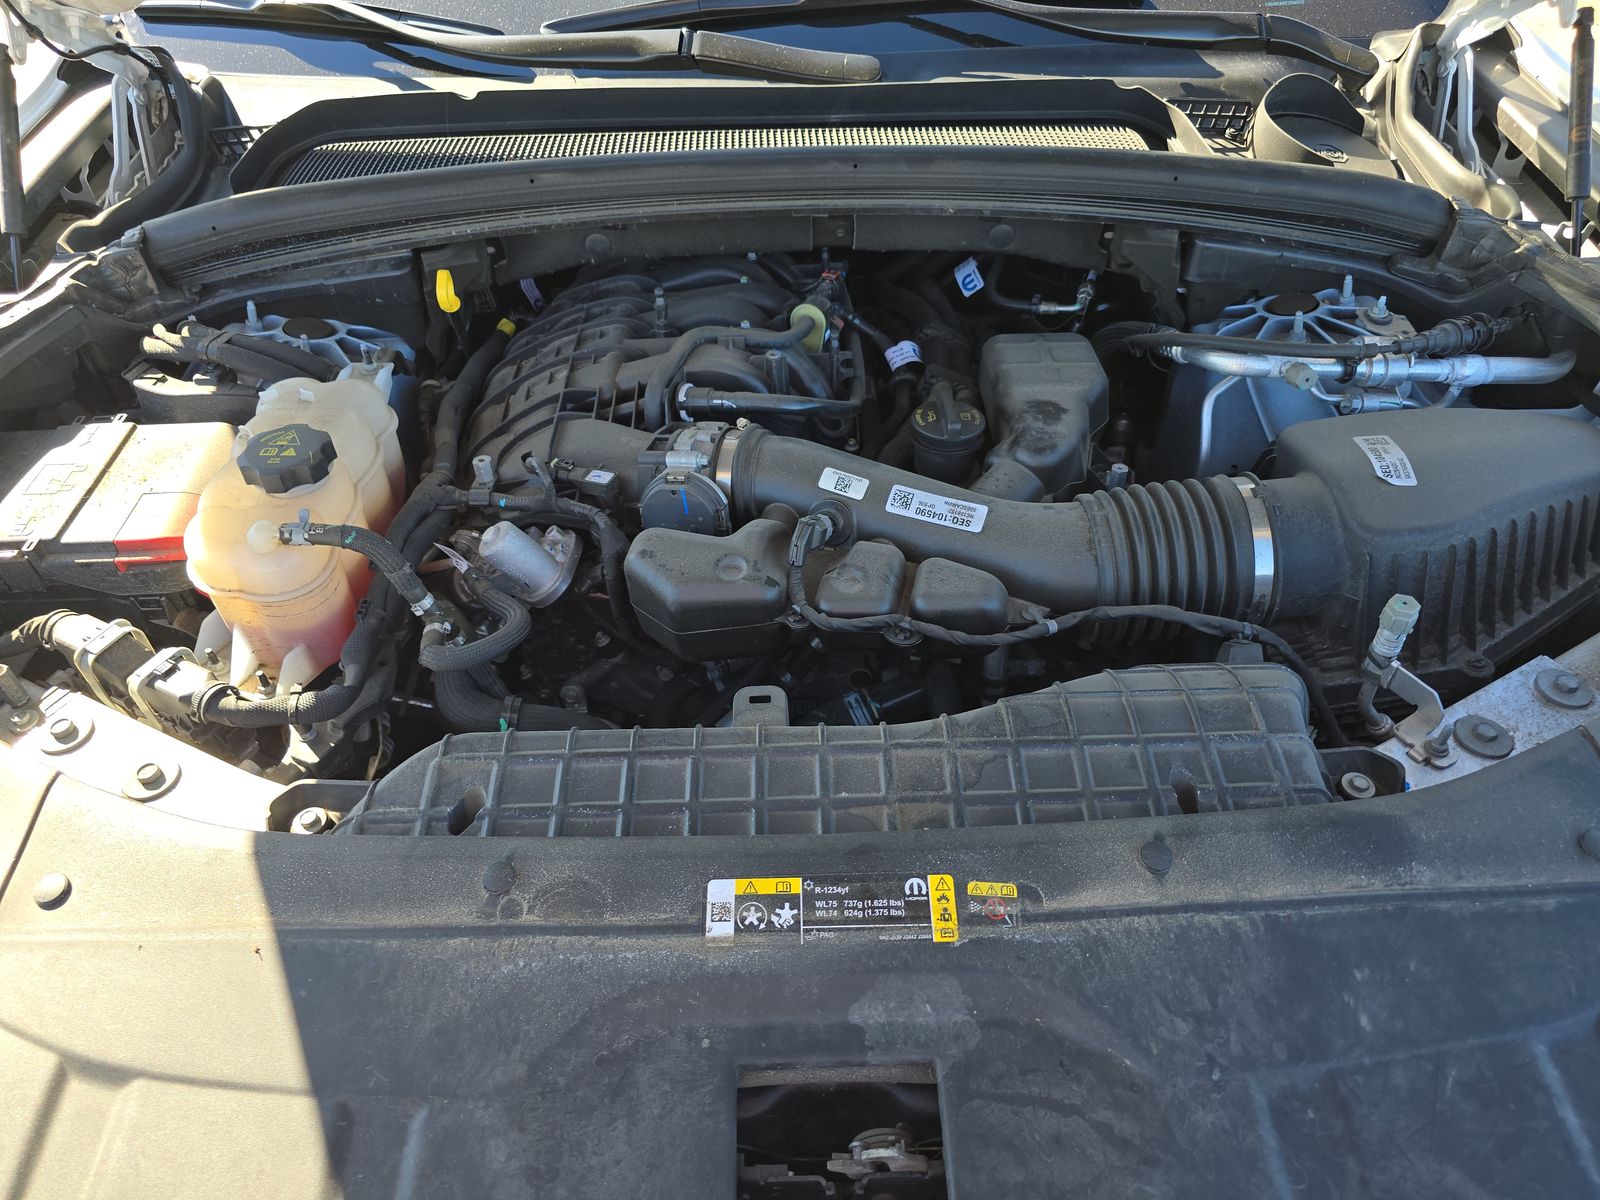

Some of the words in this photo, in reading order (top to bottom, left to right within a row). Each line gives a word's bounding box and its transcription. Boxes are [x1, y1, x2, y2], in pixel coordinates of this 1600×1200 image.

[915, 506, 972, 528] SEQ:104590
[815, 886, 849, 894] R-1234yf
[864, 900, 888, 908] (1.625
[889, 900, 905, 908] lbs)
[844, 909, 863, 917] 624g
[865, 909, 888, 917] (1.375
[890, 908, 905, 917] lbs)
